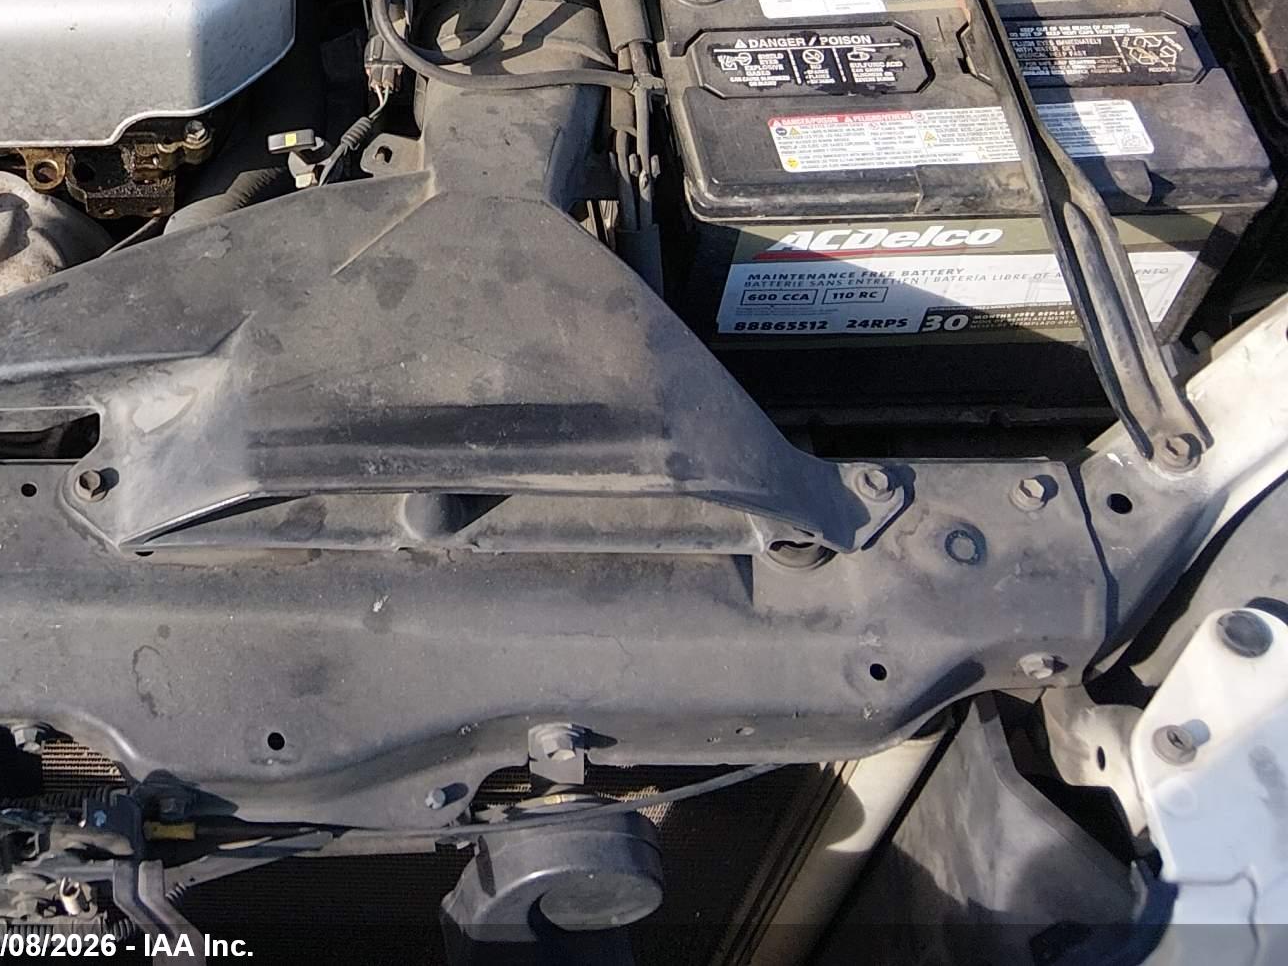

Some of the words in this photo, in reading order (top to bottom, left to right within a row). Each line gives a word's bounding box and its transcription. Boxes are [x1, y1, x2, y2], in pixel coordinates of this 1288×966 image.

[748, 37, 806, 48] DANGER
[821, 35, 872, 46] POISON
[766, 225, 1003, 251] ACDelco
[744, 280, 802, 288] BATTERIE
[809, 279, 840, 287] SANS
[847, 277, 919, 286] ENTRETIEN
[992, 273, 1026, 281] LIBRE
[747, 271, 856, 281] MAINTENANCE
[862, 270, 895, 278] FREE
[901, 268, 965, 277] BATTERY
[748, 293, 779, 301] 600
[782, 292, 810, 301] CCA
[832, 291, 854, 300] 110
[858, 290, 878, 299] RC
[734, 320, 828, 331] 88865512
[846, 318, 908, 329] 24RPS
[921, 314, 968, 333] 30
